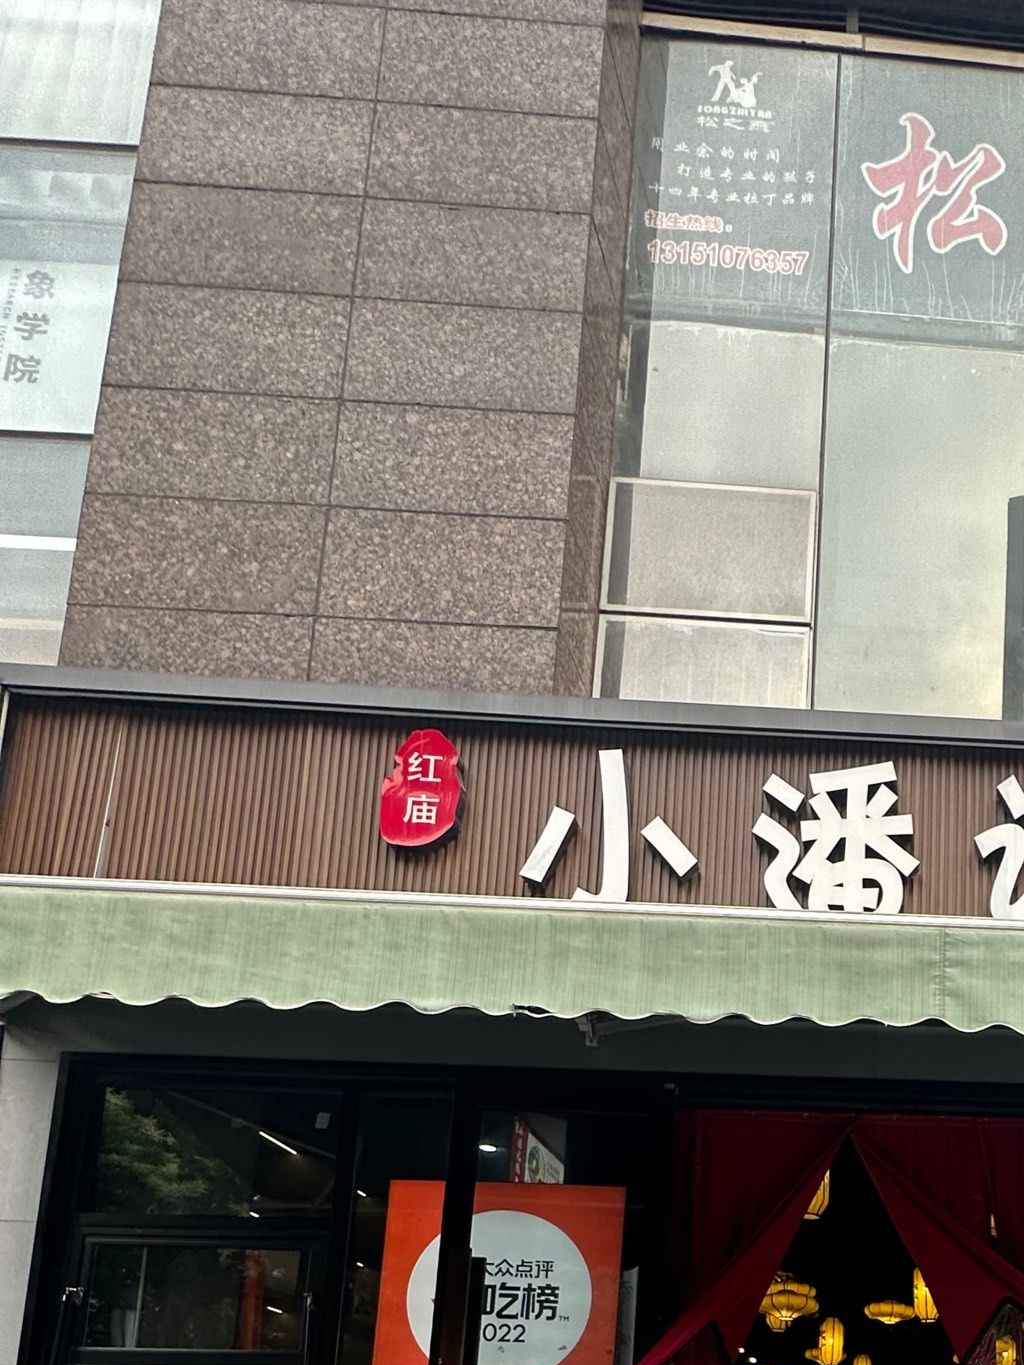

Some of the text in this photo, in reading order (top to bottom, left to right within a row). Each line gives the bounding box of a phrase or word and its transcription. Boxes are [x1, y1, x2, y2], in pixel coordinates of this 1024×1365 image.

[647, 238, 809, 276] 13151076357
[402, 751, 443, 827] 红庙
[481, 1282, 560, 1322] 吃榜
[482, 1322, 526, 1343] 022
